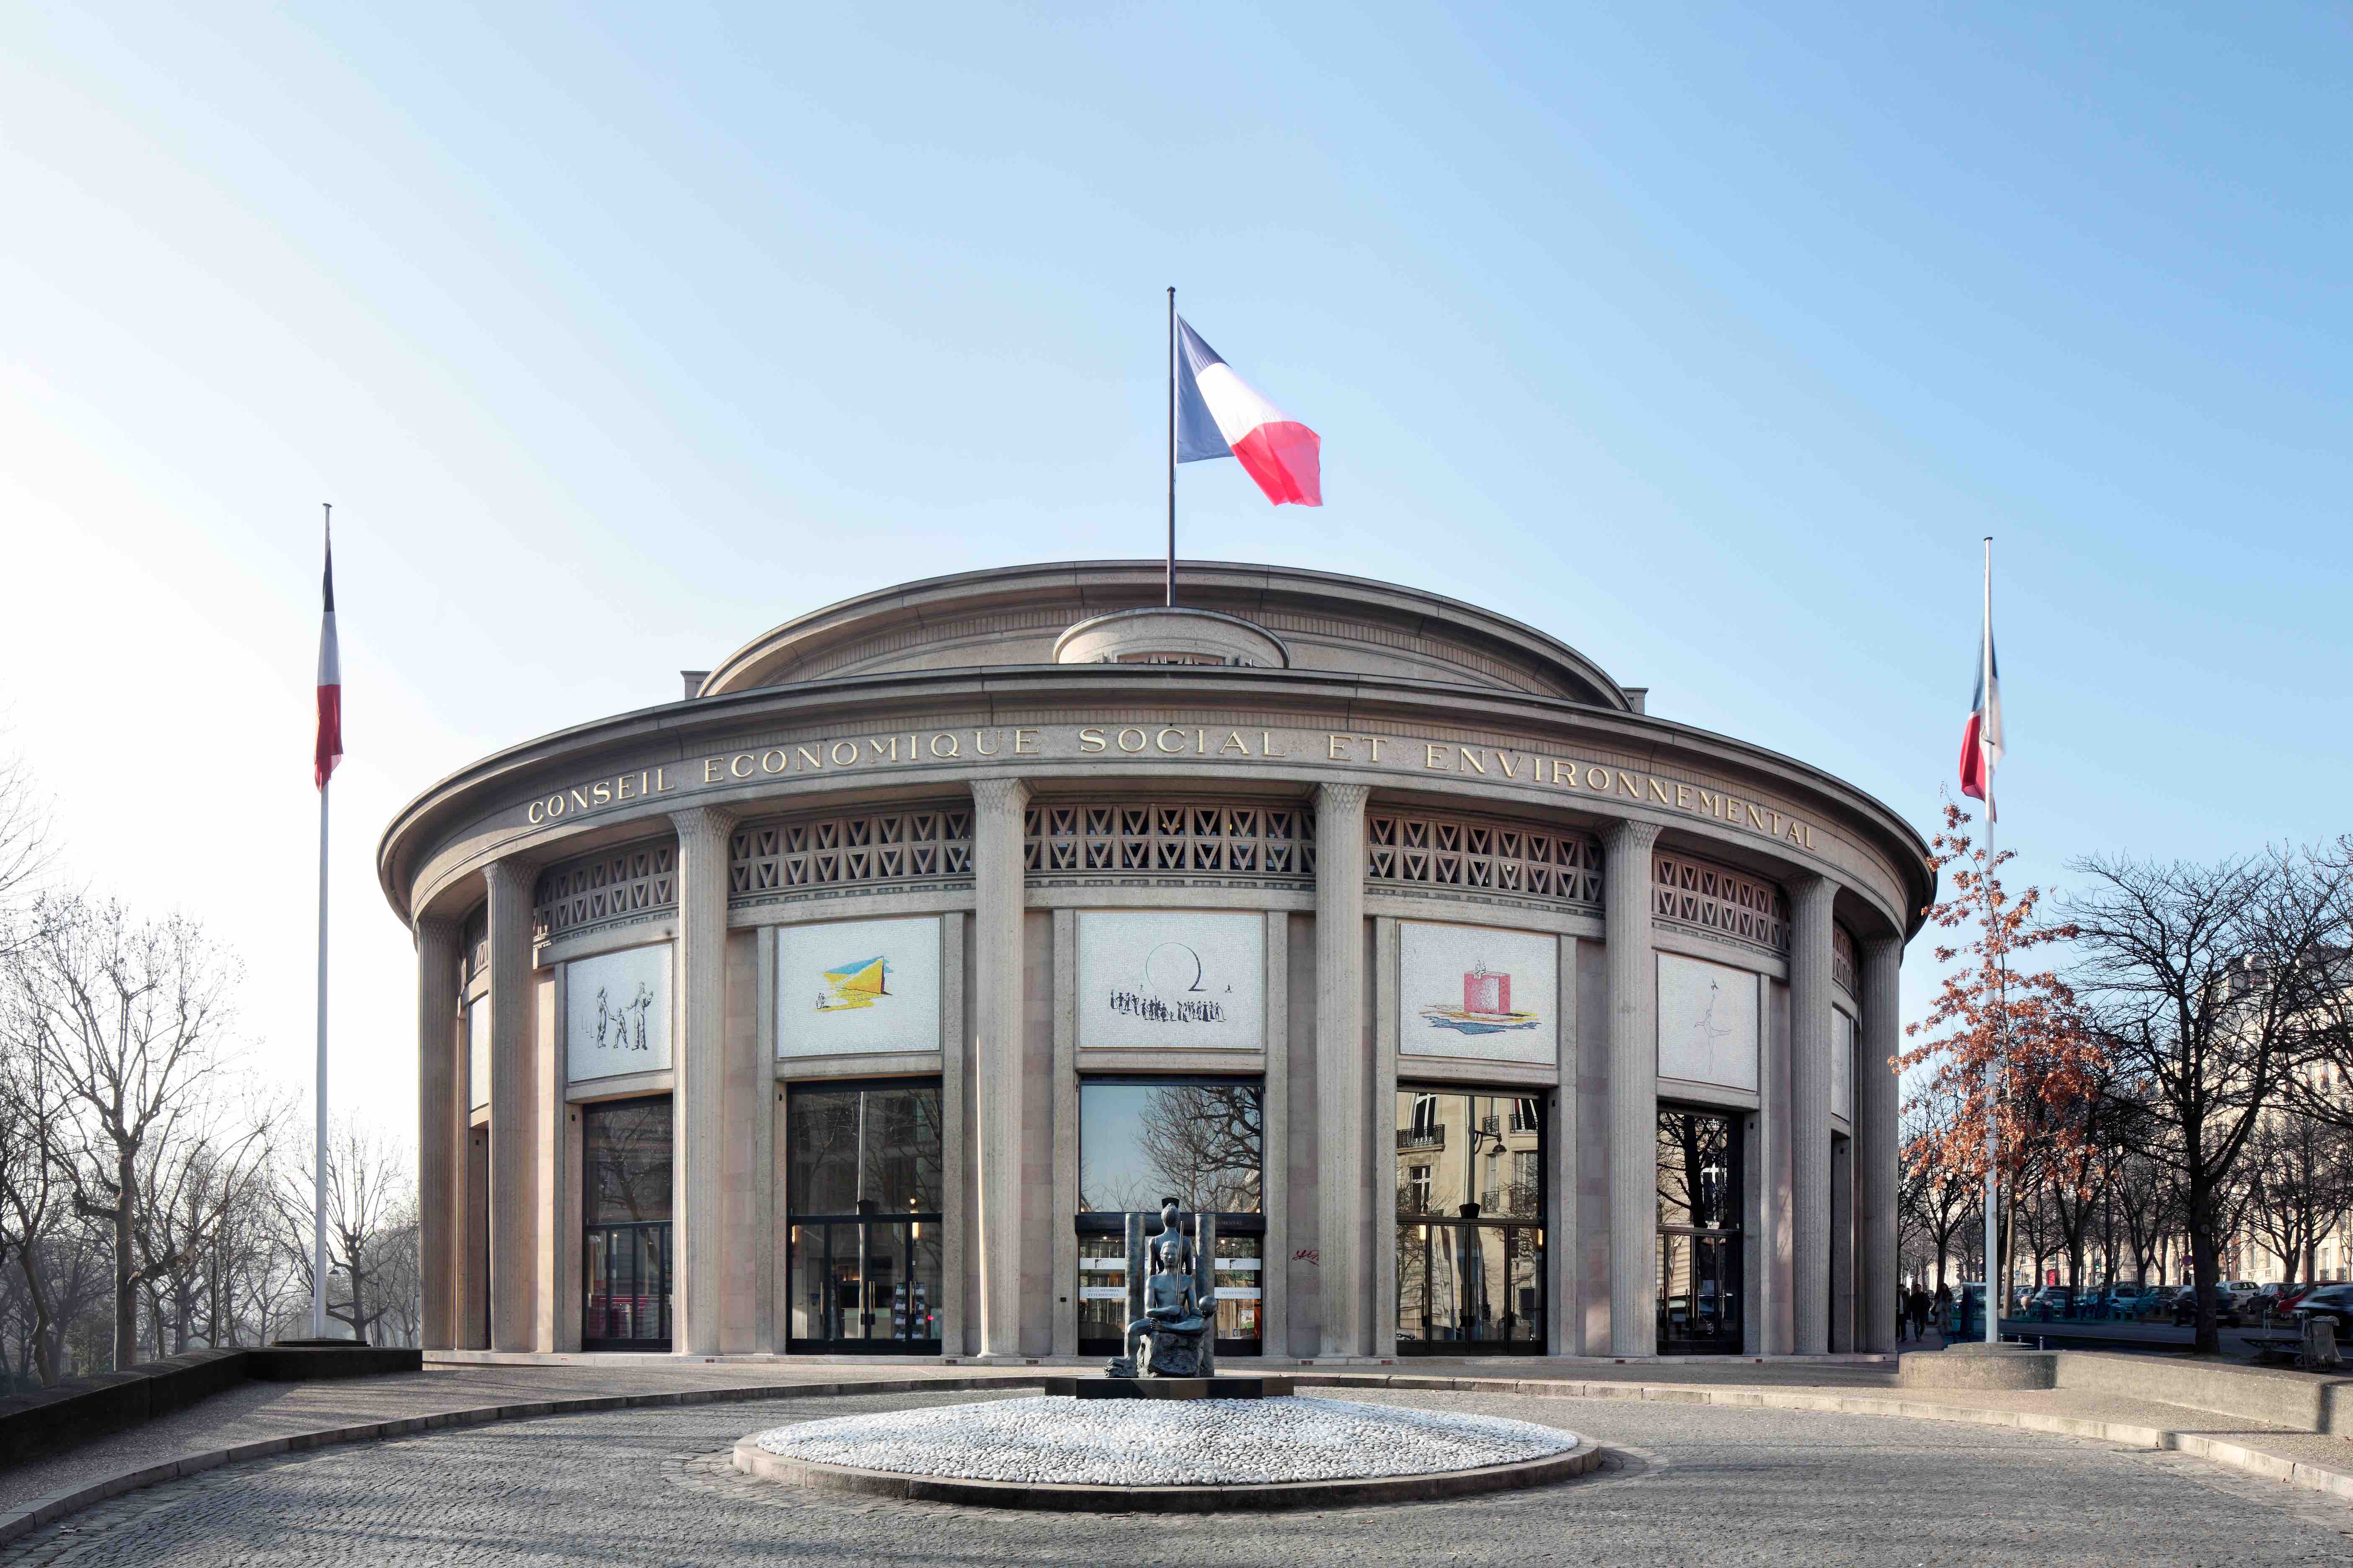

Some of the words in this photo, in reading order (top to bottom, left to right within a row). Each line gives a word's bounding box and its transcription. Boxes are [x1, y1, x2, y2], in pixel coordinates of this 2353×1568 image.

[528, 767, 675, 824] CONSEIL
[704, 729, 1039, 784] ECONOMIQUE
[1079, 728, 1286, 756] SOCIAL
[1328, 735, 1388, 763] ET
[1426, 744, 1816, 851] ENVIRONNEMENTAL
